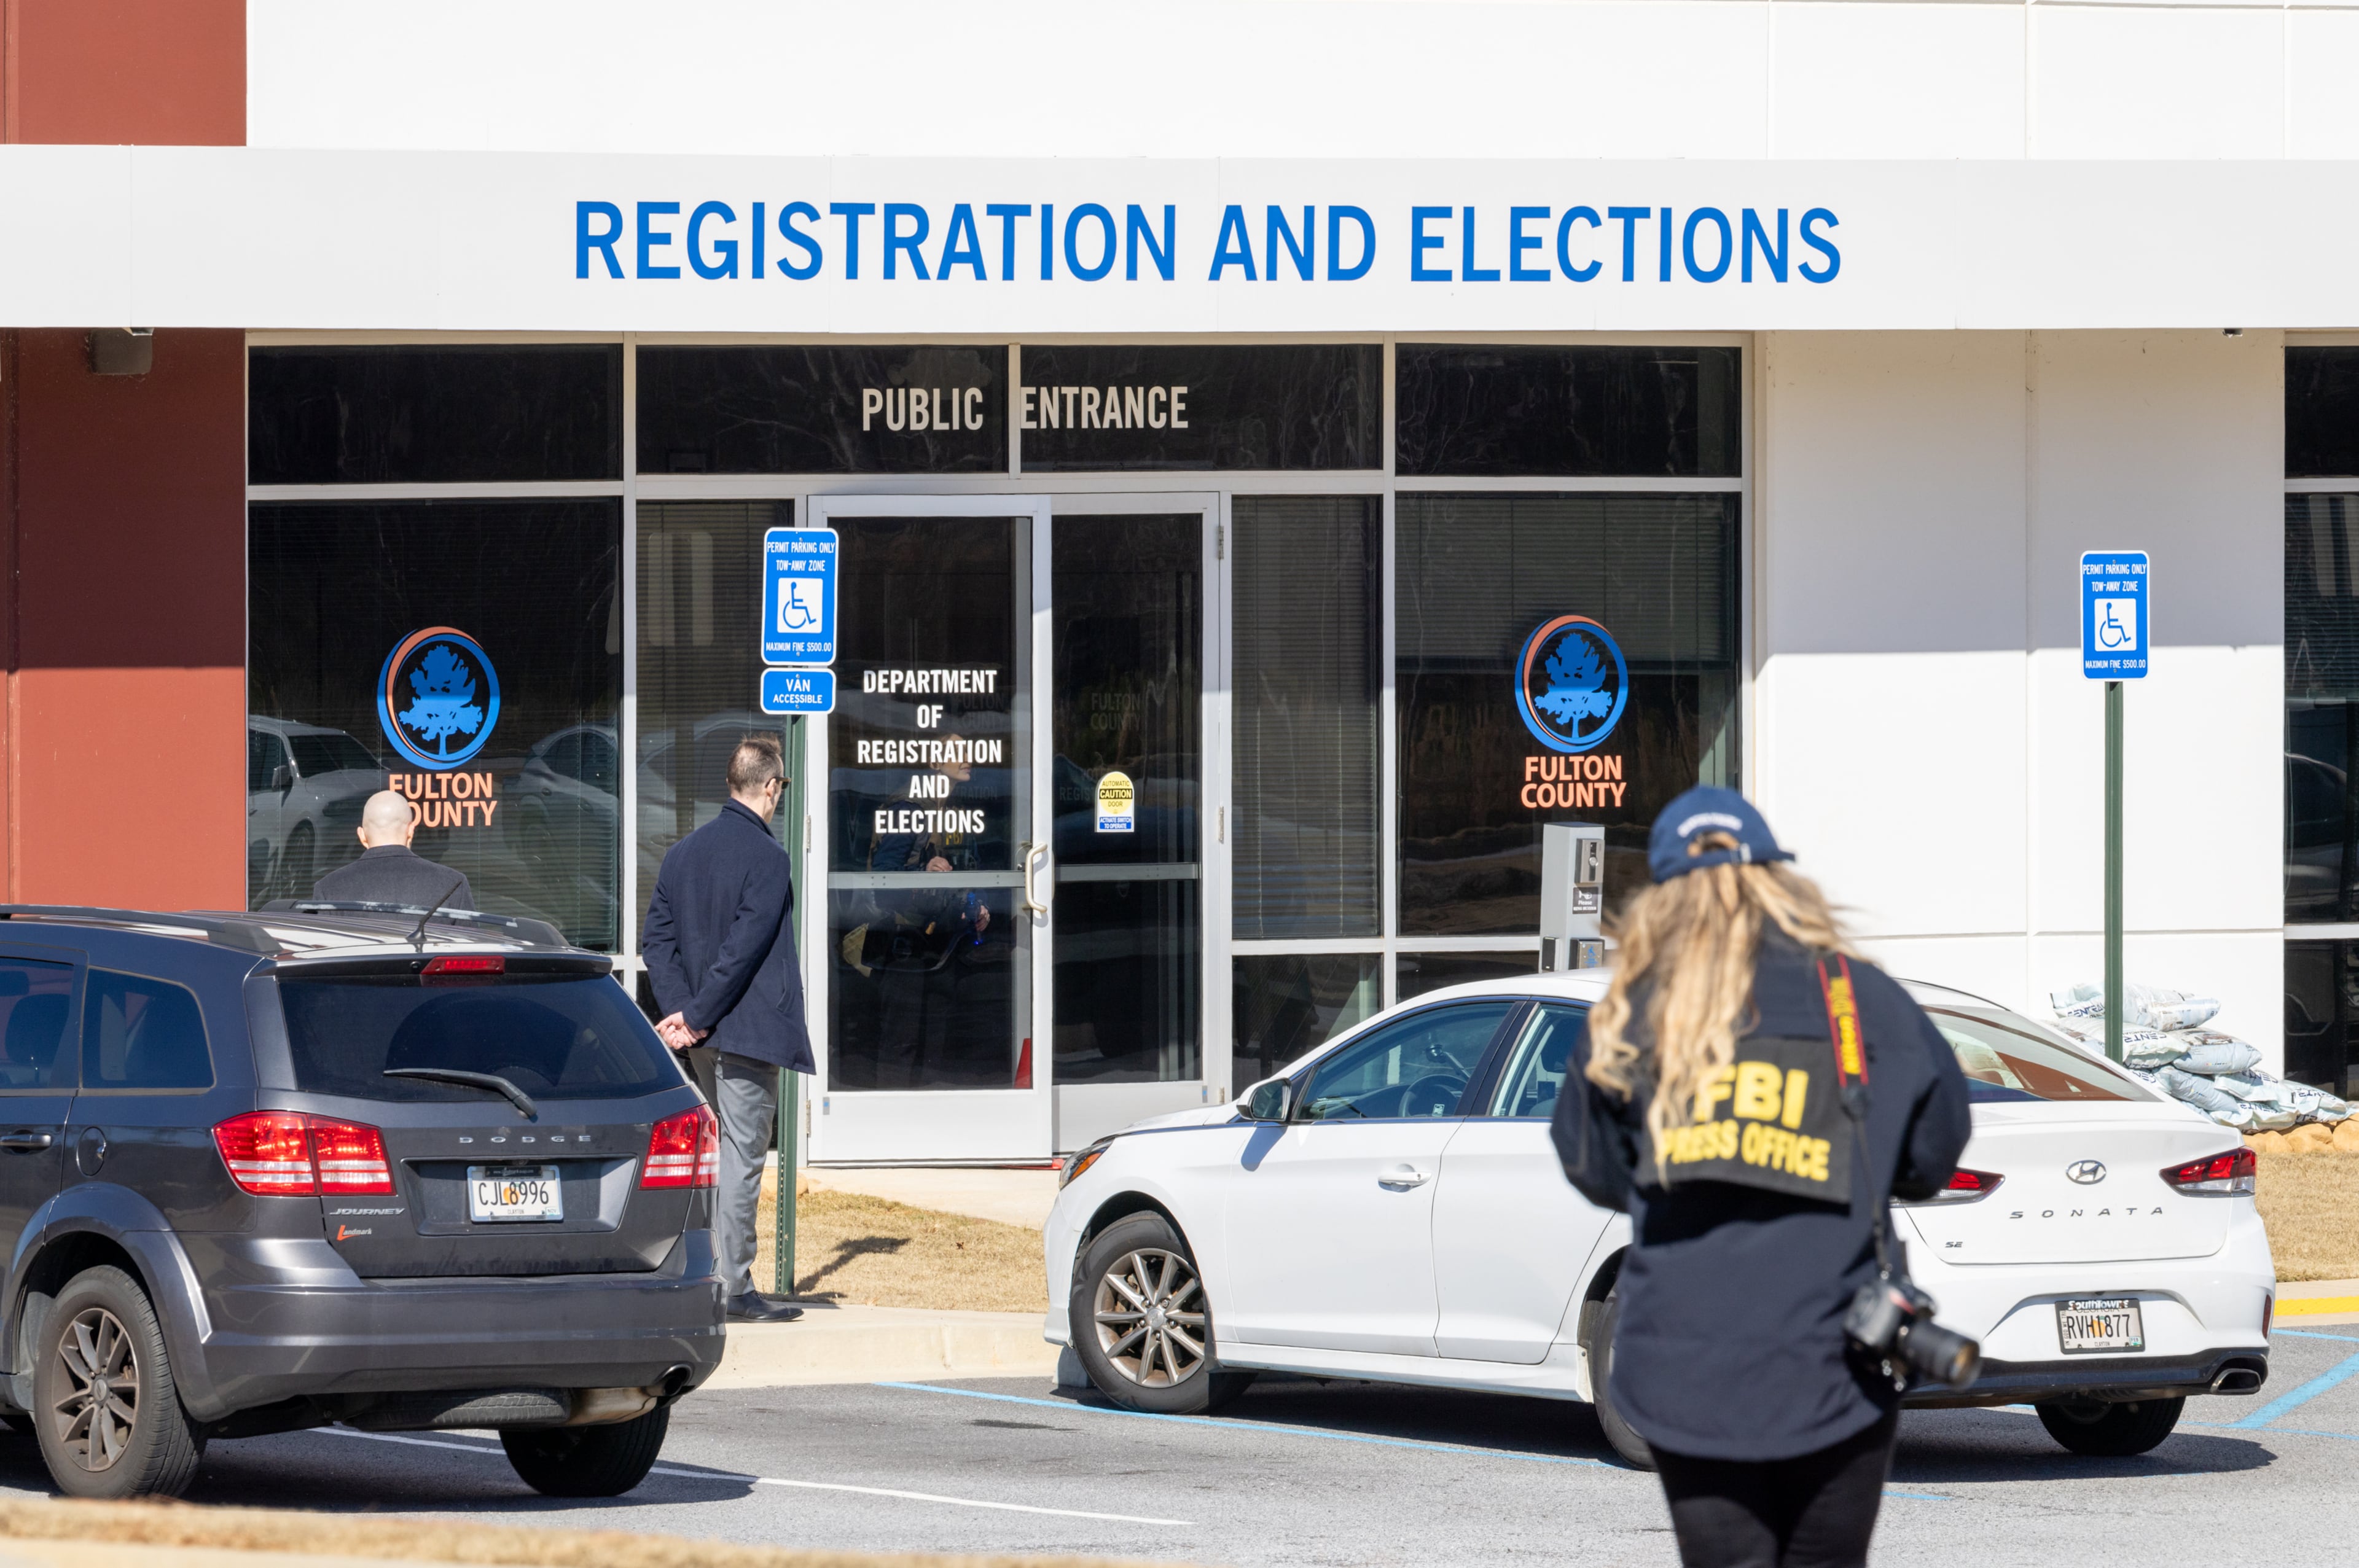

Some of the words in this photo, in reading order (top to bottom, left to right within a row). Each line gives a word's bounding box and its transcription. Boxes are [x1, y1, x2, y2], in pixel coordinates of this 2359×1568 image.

[576, 201, 1175, 282] REGISTRATION
[1208, 205, 1376, 281] AND
[1411, 206, 1841, 283] ELECTIONS
[863, 388, 983, 431] PUBLIC
[1020, 386, 1188, 429] ENTRANCE
[767, 542, 789, 553] PERMIT
[791, 542, 817, 553] PARKING
[820, 542, 835, 553] ONLY
[777, 560, 806, 571] TOW-AWAY
[808, 560, 826, 571] ZONE
[2083, 564, 2103, 574] PERMIT
[2106, 564, 2130, 574] PARKING
[2132, 564, 2147, 574] ONLY
[2091, 581, 2120, 591] TOW-AWAY
[2122, 581, 2138, 591] ZONE
[766, 642, 791, 652] MAXIMUM
[792, 642, 805, 652] FINE
[807, 642, 831, 652] $500.00
[2085, 660, 2108, 669] MAXIMUM
[2110, 660, 2121, 669] FINE
[2122, 659, 2146, 668] $500.00
[786, 679, 810, 692] VAN
[863, 669, 997, 693] DEPARTMENT
[773, 694, 823, 704] ACCESSIBLE
[1091, 693, 1141, 711] FULTON
[917, 705, 944, 728] OF
[858, 739, 1002, 763] REGISTRATION
[1525, 755, 1622, 781] FULTON
[389, 772, 492, 800] FULTON
[909, 774, 950, 798] AND
[1100, 789, 1132, 798] CAUTION
[1521, 782, 1627, 808] COUNTY
[410, 800, 498, 827] OUNTY
[875, 809, 985, 834] ELECTIONS
[1694, 1061, 1809, 1129] FBI
[1741, 1121, 1831, 1182] OFFICE
[479, 1182, 549, 1206] CJL8996
[2009, 1207, 2163, 1219] SONATA
[337, 1225, 372, 1241] Landmark
[2067, 1314, 2130, 1339] RVH1877
